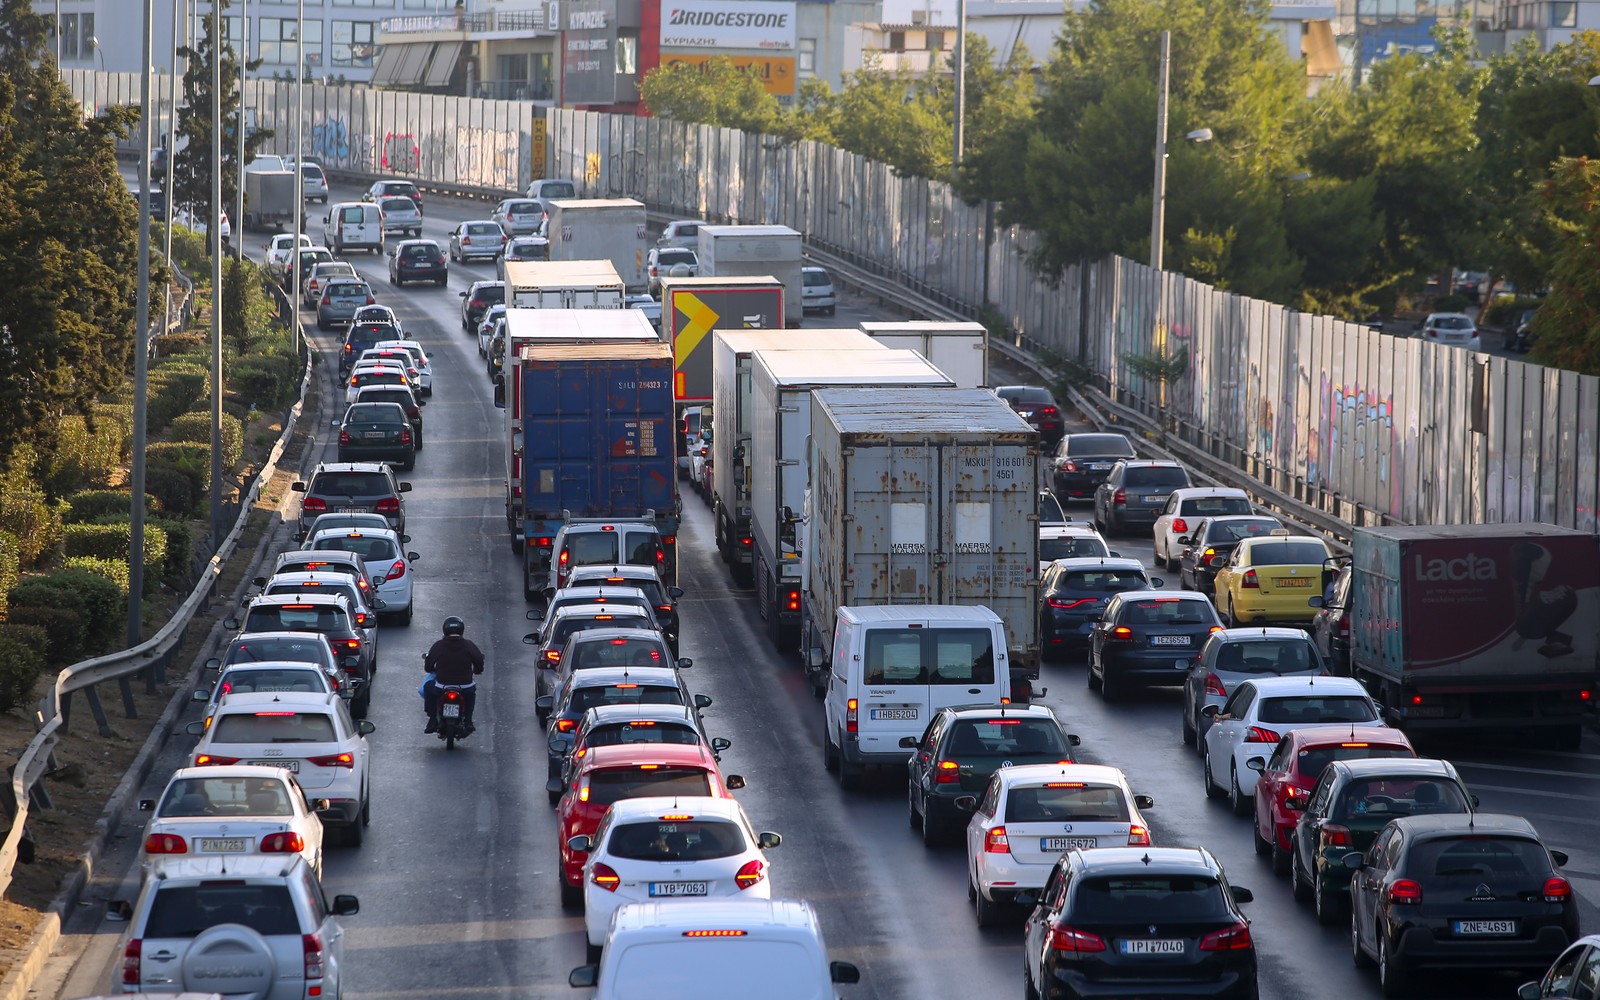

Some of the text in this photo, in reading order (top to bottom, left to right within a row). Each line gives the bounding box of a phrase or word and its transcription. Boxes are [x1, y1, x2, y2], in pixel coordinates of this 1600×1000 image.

[404, 16, 433, 31] SERVICE
[669, 9, 788, 28] BRIDGESTONE
[664, 37, 717, 45] ΚΥΡΙΑΖΗΣ
[965, 457, 986, 467] MSKU
[996, 470, 1014, 479] 45G1
[1415, 553, 1497, 581] Lacta
